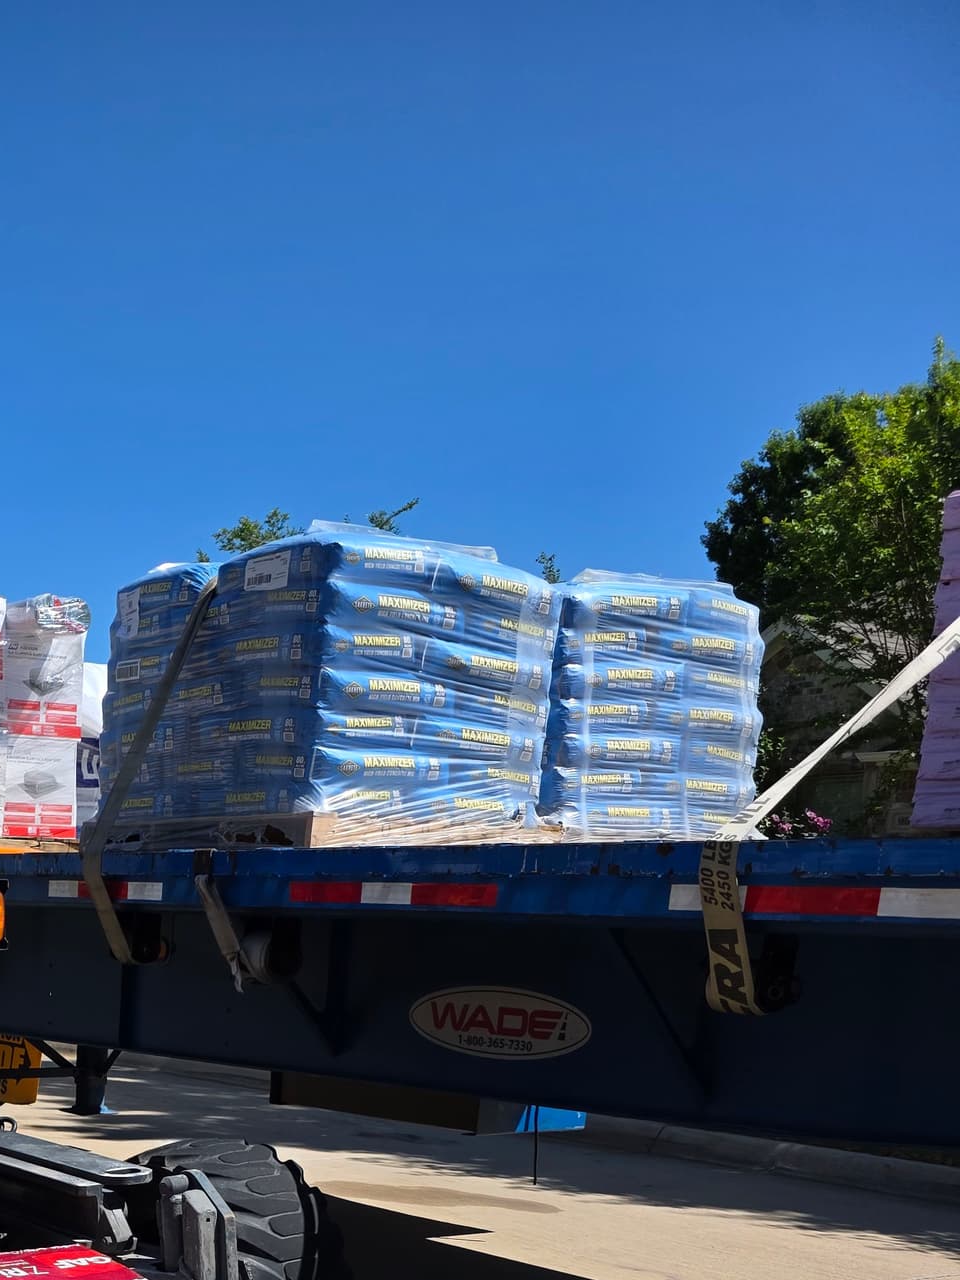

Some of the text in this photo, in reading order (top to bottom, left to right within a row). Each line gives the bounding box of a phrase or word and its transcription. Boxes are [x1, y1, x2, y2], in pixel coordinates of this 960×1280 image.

[365, 547, 414, 561] MAXIMIZER
[482, 574, 528, 596] MAXIMIZER
[379, 595, 431, 614] MAXIMIZER
[612, 596, 657, 607] MAXIMIZER
[236, 636, 279, 650] MAXIMIZER
[354, 635, 401, 647] MAXIMIZER
[584, 632, 626, 643] MAXIMIZER
[692, 638, 736, 651] MAXIMIZER
[471, 656, 519, 673] MAXIMIZER
[607, 669, 654, 681] MAXIMIZER
[369, 679, 421, 693] MAXIMIZER
[587, 705, 628, 715] MAXIMIZER
[689, 709, 734, 723] MAXIMIZER
[229, 720, 272, 731] MAXIMIZER
[346, 717, 393, 728] MAXIMIZER
[462, 728, 511, 746] MAXIMIZER
[607, 740, 651, 751] MAXIMIZER
[364, 757, 416, 769] MAXIMIZER
[581, 774, 622, 785] MAXIMIZER
[607, 807, 650, 817] MAXIMIZER
[700, 867, 719, 905] 5400
[716, 871, 735, 912] 2450
[431, 1001, 564, 1040] WADE
[458, 1034, 533, 1051] 1-800-365-7330
[53, 1256, 112, 1269] GAF
